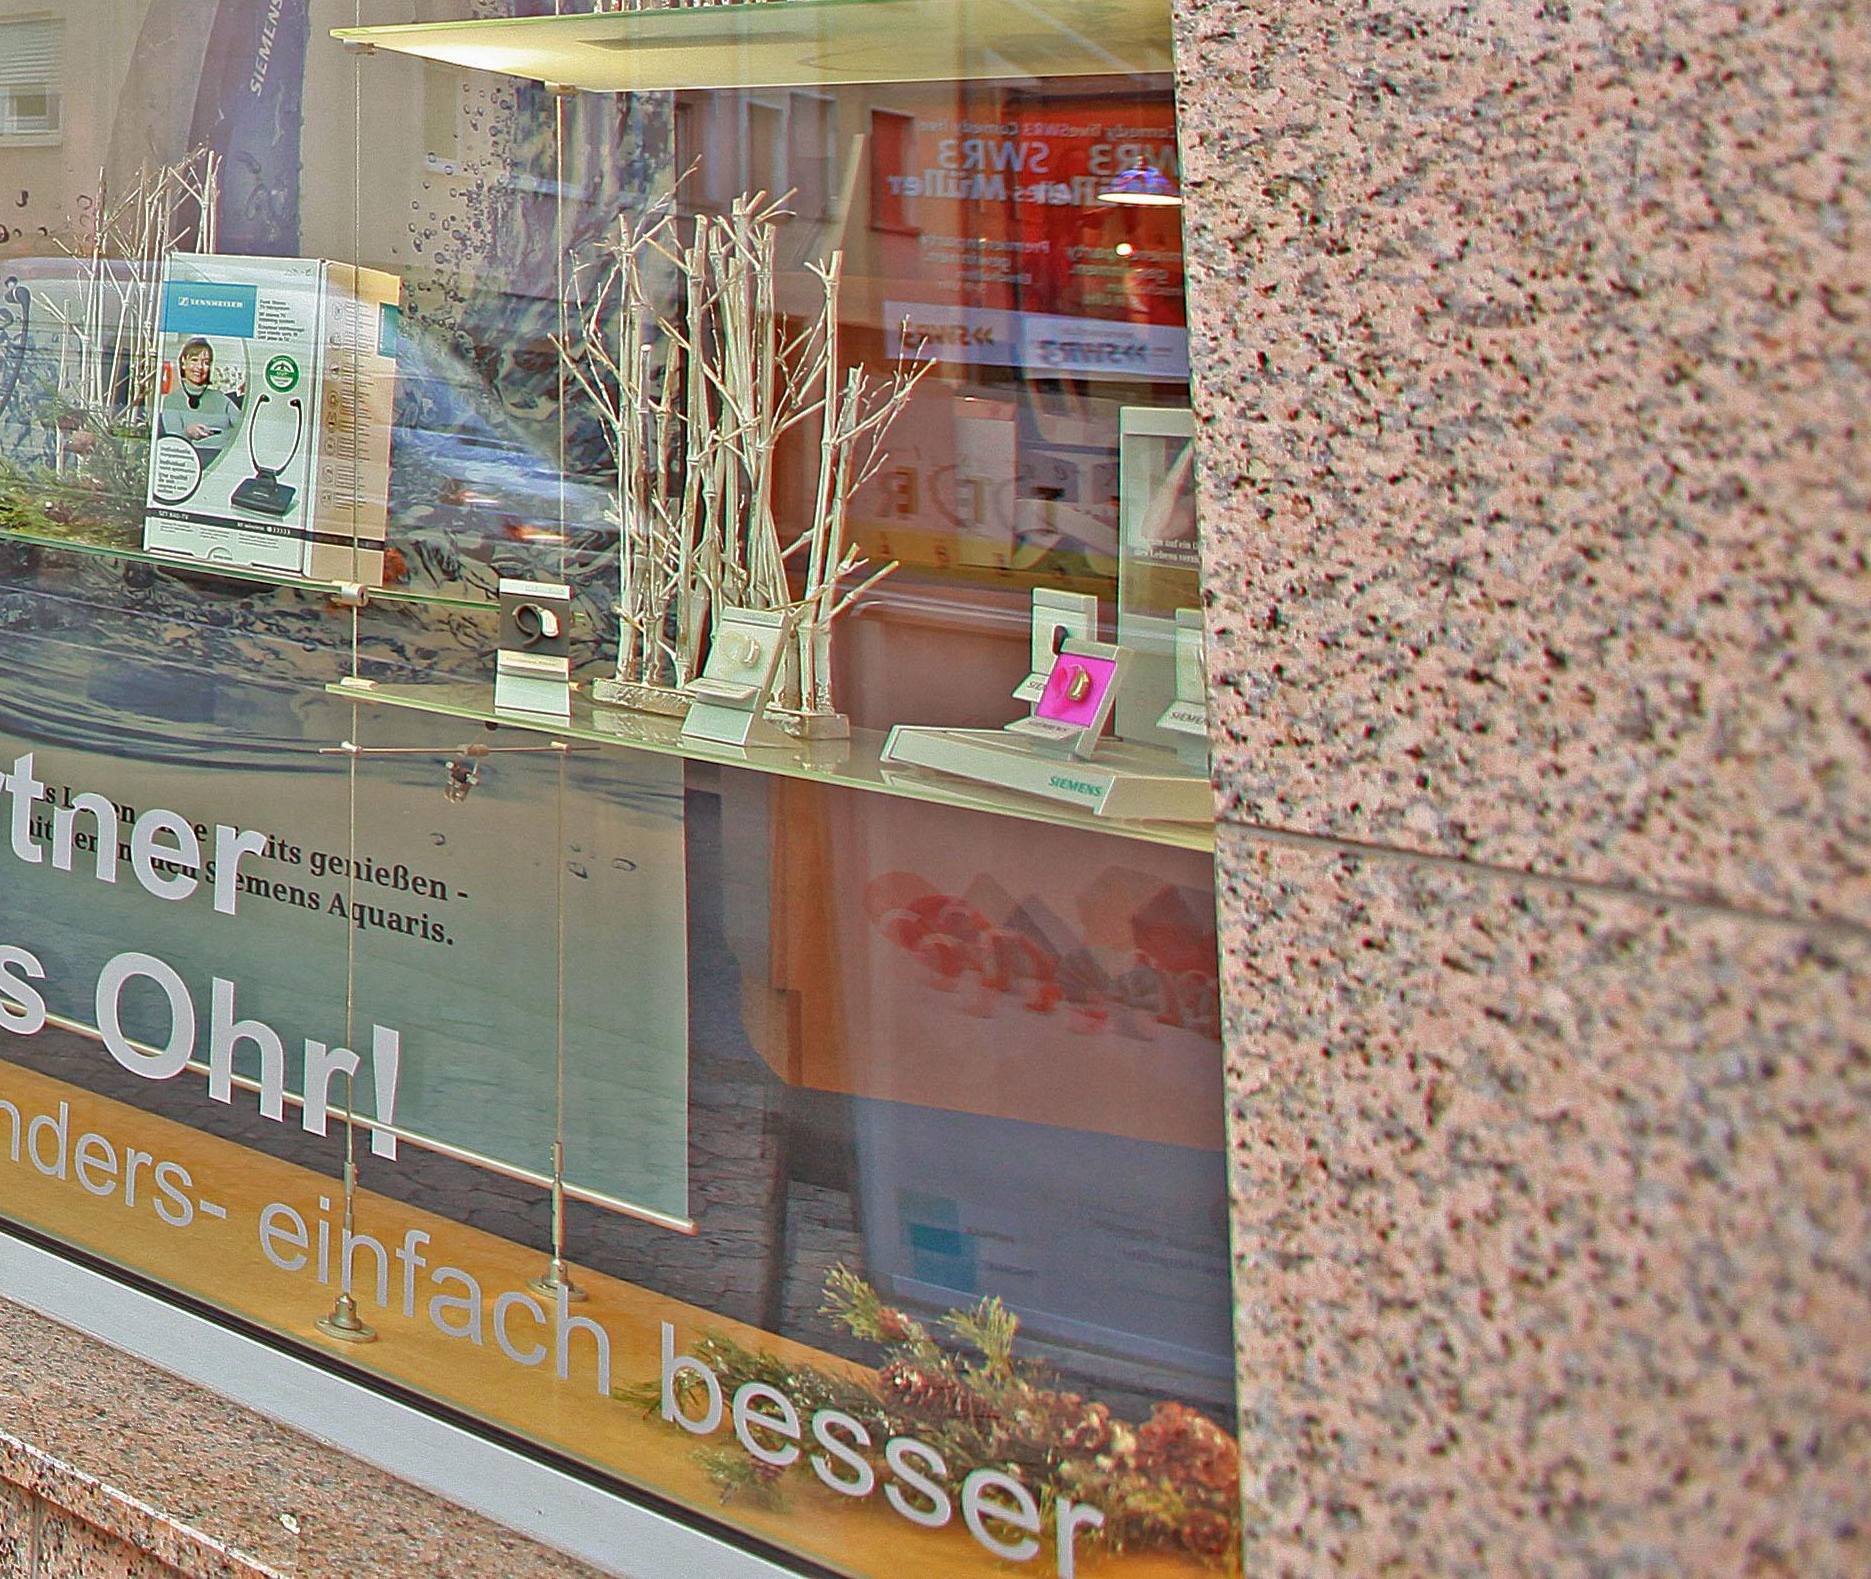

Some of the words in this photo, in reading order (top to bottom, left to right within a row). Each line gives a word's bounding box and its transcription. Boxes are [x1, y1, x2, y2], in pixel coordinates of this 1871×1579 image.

[1049, 775, 1103, 797] SIEMENS
[205, 858, 321, 911] Semens
[328, 892, 454, 946] Aquaris.
[310, 848, 449, 901] genießen
[96, 950, 399, 1162] Ohr!
[260, 1194, 611, 1396] einfach
[660, 1321, 1105, 1579] besser
